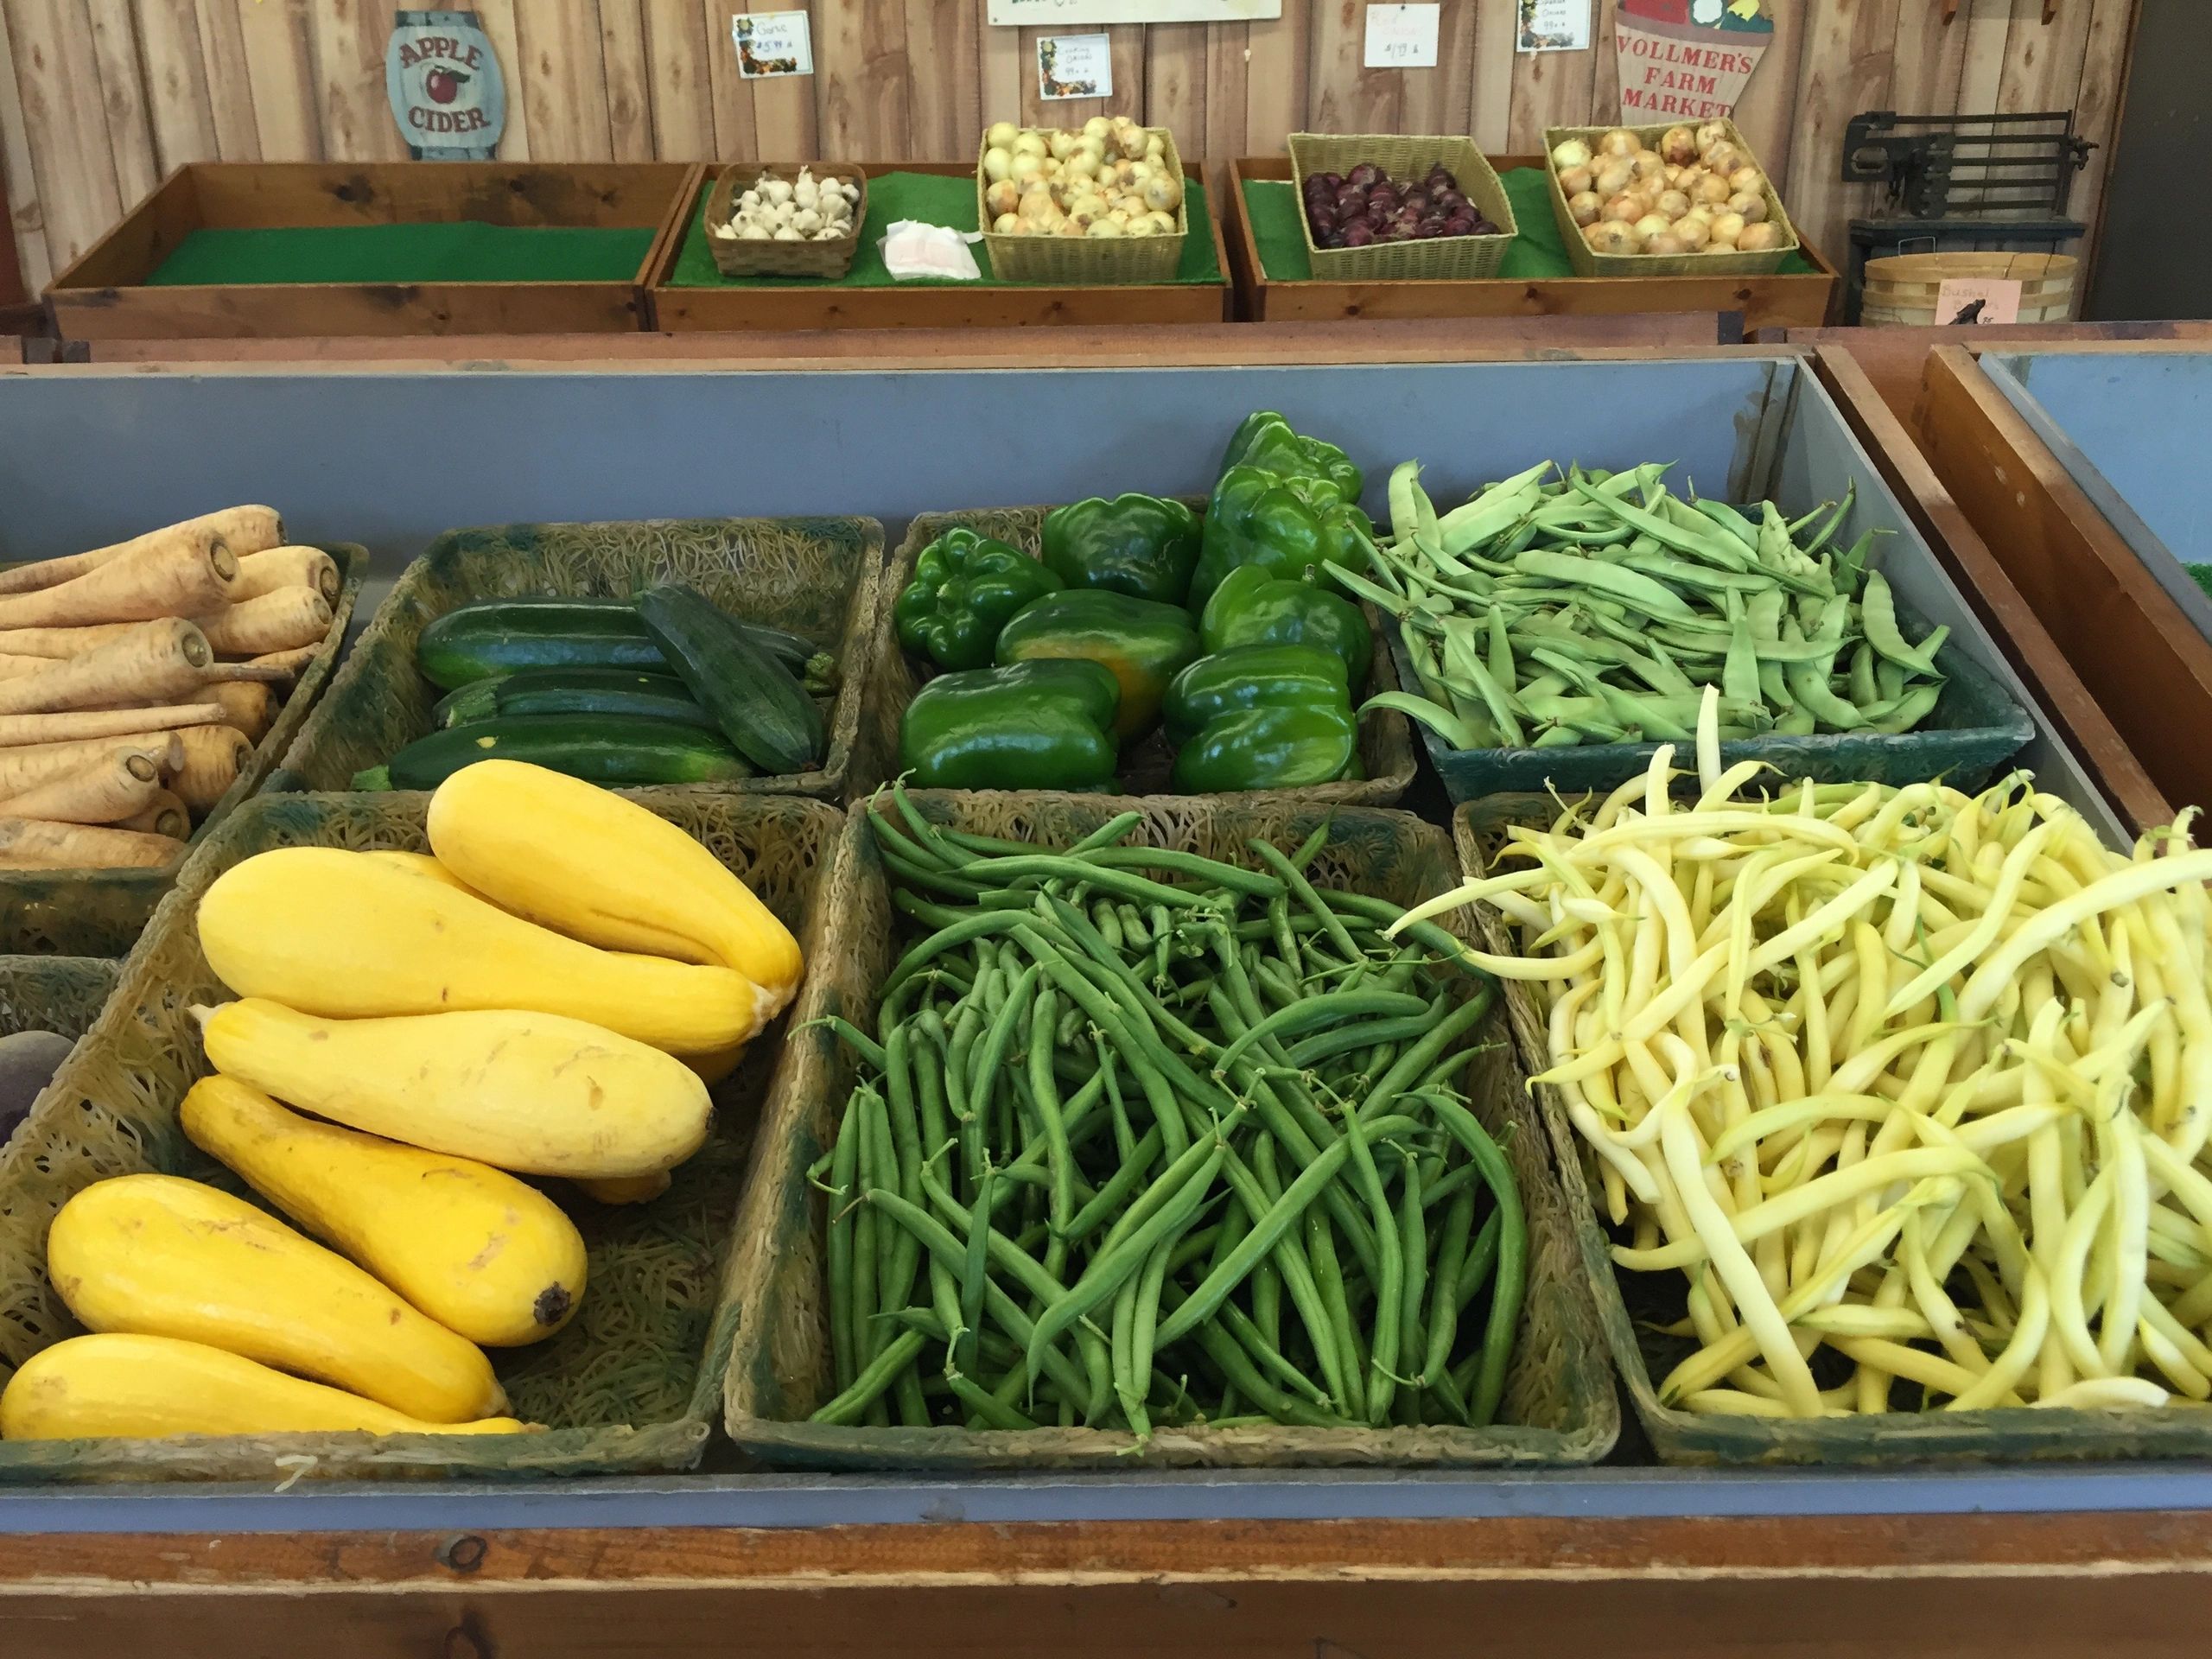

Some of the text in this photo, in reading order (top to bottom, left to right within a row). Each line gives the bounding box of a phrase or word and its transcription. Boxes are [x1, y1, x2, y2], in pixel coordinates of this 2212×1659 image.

[399, 36, 483, 71] APPLE
[1617, 35, 1754, 75] VOLLMER'S
[1644, 66, 1718, 95] FARM
[408, 105, 492, 133] CIDER
[1622, 87, 1733, 119] MARKET
